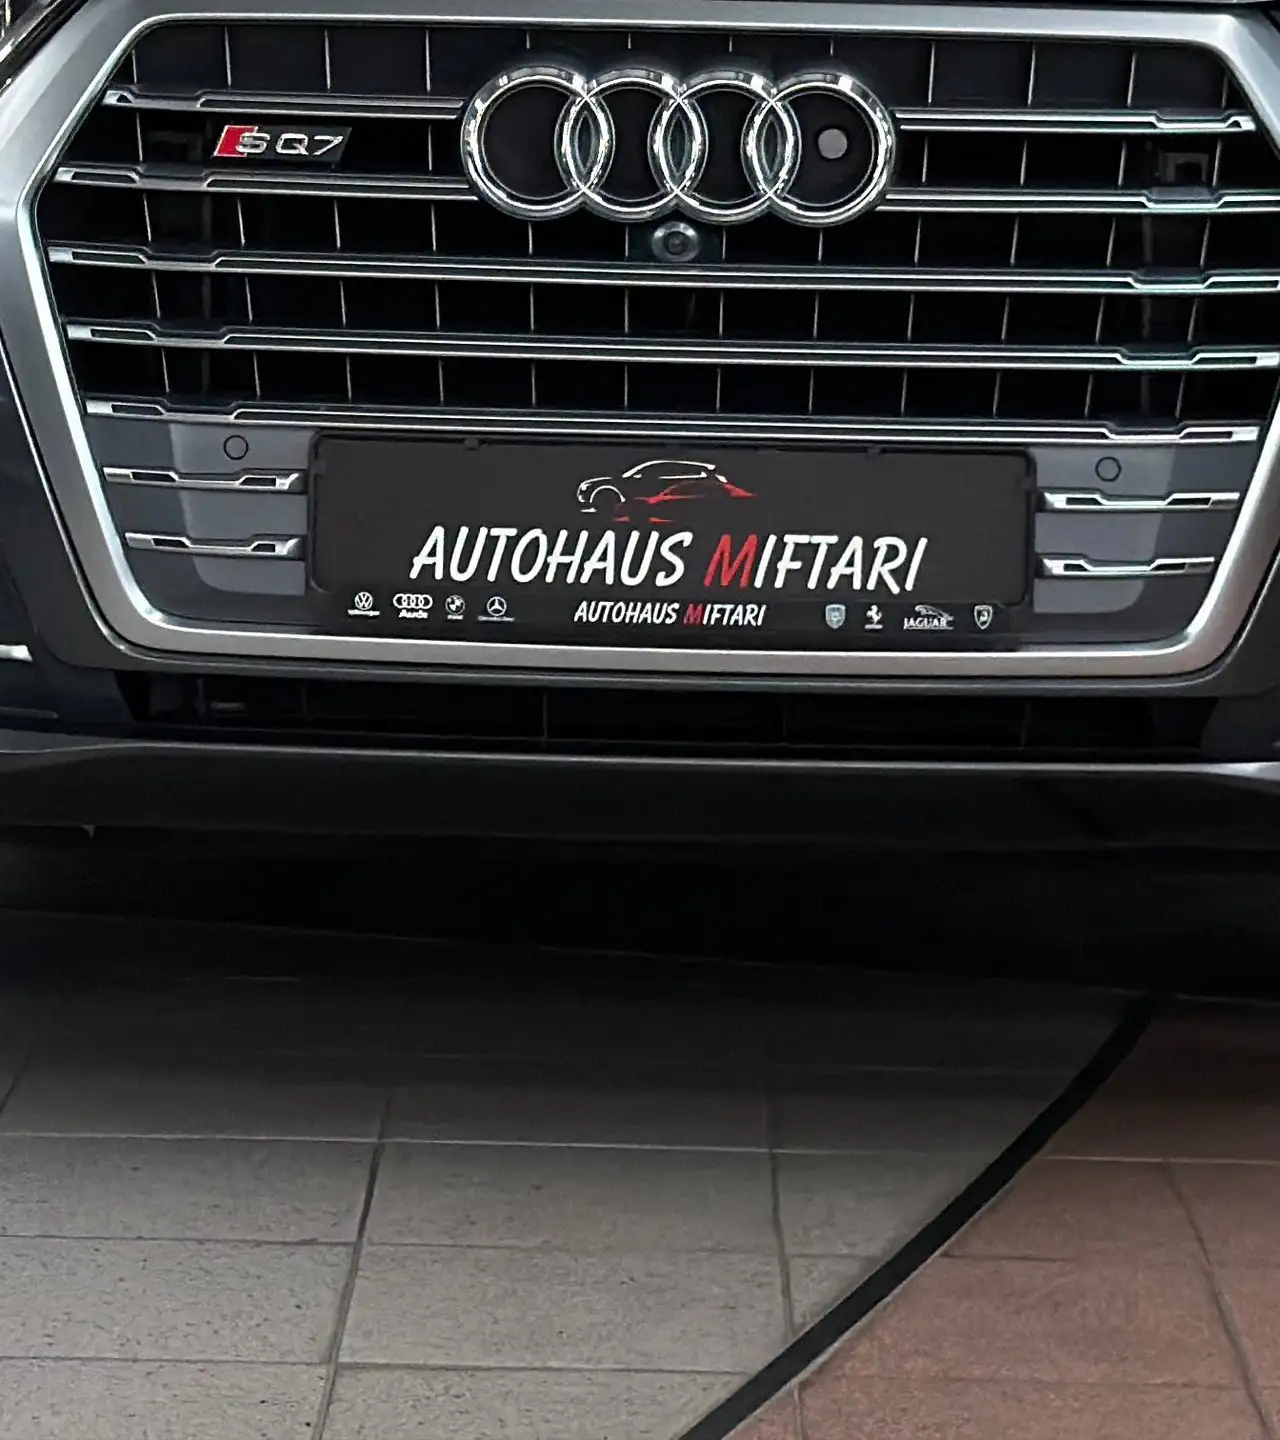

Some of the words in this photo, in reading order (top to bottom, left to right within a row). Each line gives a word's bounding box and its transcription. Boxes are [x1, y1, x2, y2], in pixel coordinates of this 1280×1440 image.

[234, 132, 344, 156] SQ7
[408, 524, 694, 589] AUTOHAUS
[703, 532, 929, 594] MIFTARI
[572, 600, 680, 625] AUTOHAUS
[683, 603, 768, 627] MIFTARI
